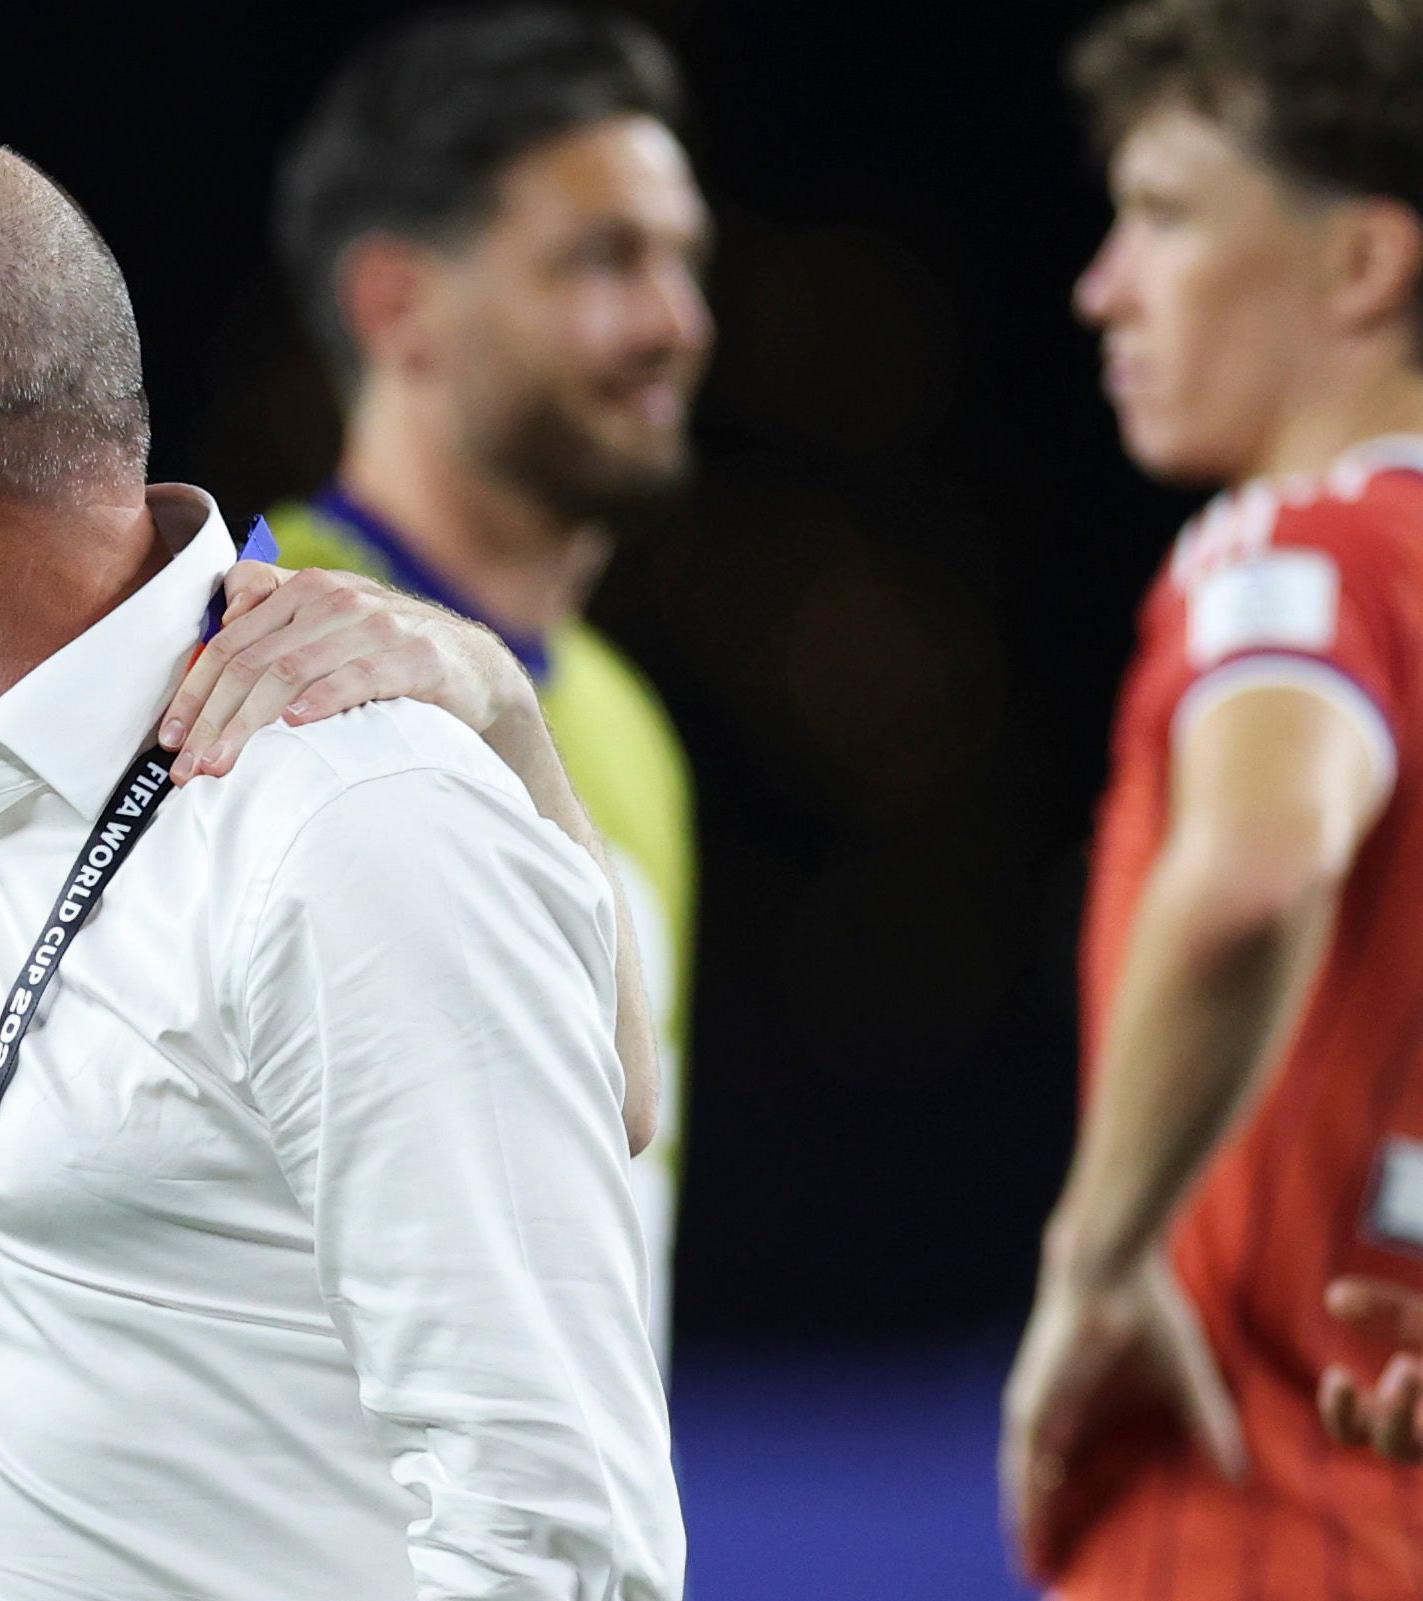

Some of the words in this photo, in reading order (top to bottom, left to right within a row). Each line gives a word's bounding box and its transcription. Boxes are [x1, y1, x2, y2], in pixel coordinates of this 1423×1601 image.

[115, 761, 168, 817] FIFA
[58, 822, 131, 922] WORLD
[28, 926, 65, 985] CUP
